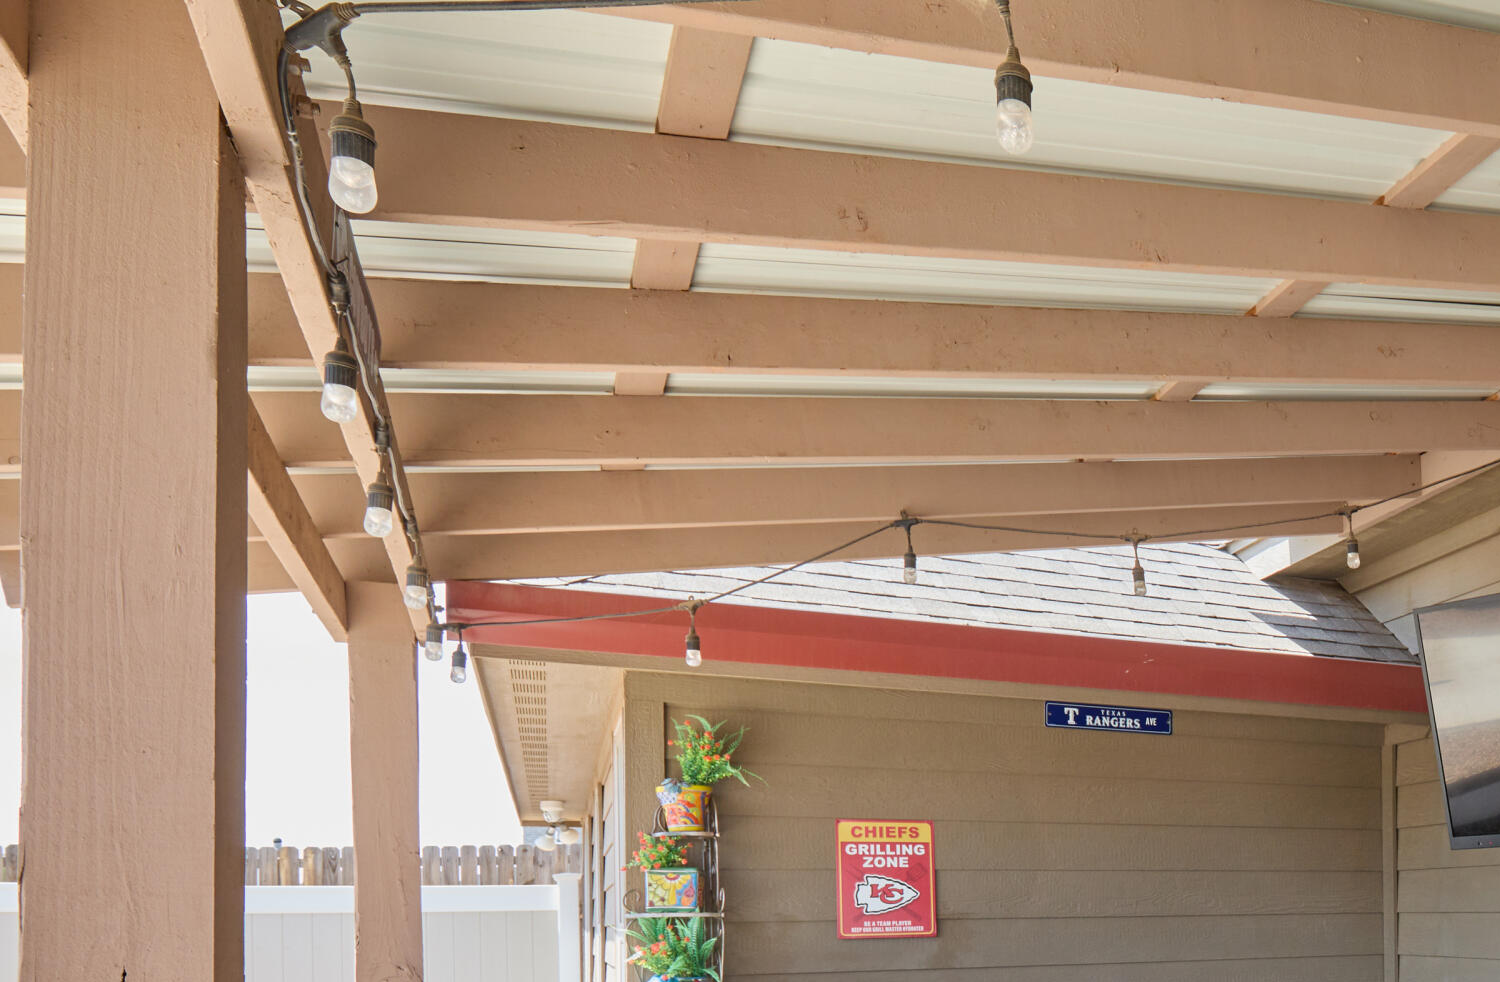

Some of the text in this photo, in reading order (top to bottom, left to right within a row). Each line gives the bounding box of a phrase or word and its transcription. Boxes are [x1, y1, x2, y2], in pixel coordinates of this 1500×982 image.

[1064, 707, 1079, 724] T
[1086, 715, 1157, 729] RANGERS AVE
[851, 826, 919, 839] CHIEFS
[845, 844, 925, 855] GRILLING
[862, 857, 909, 868] ZONE
[870, 883, 904, 905] KC
